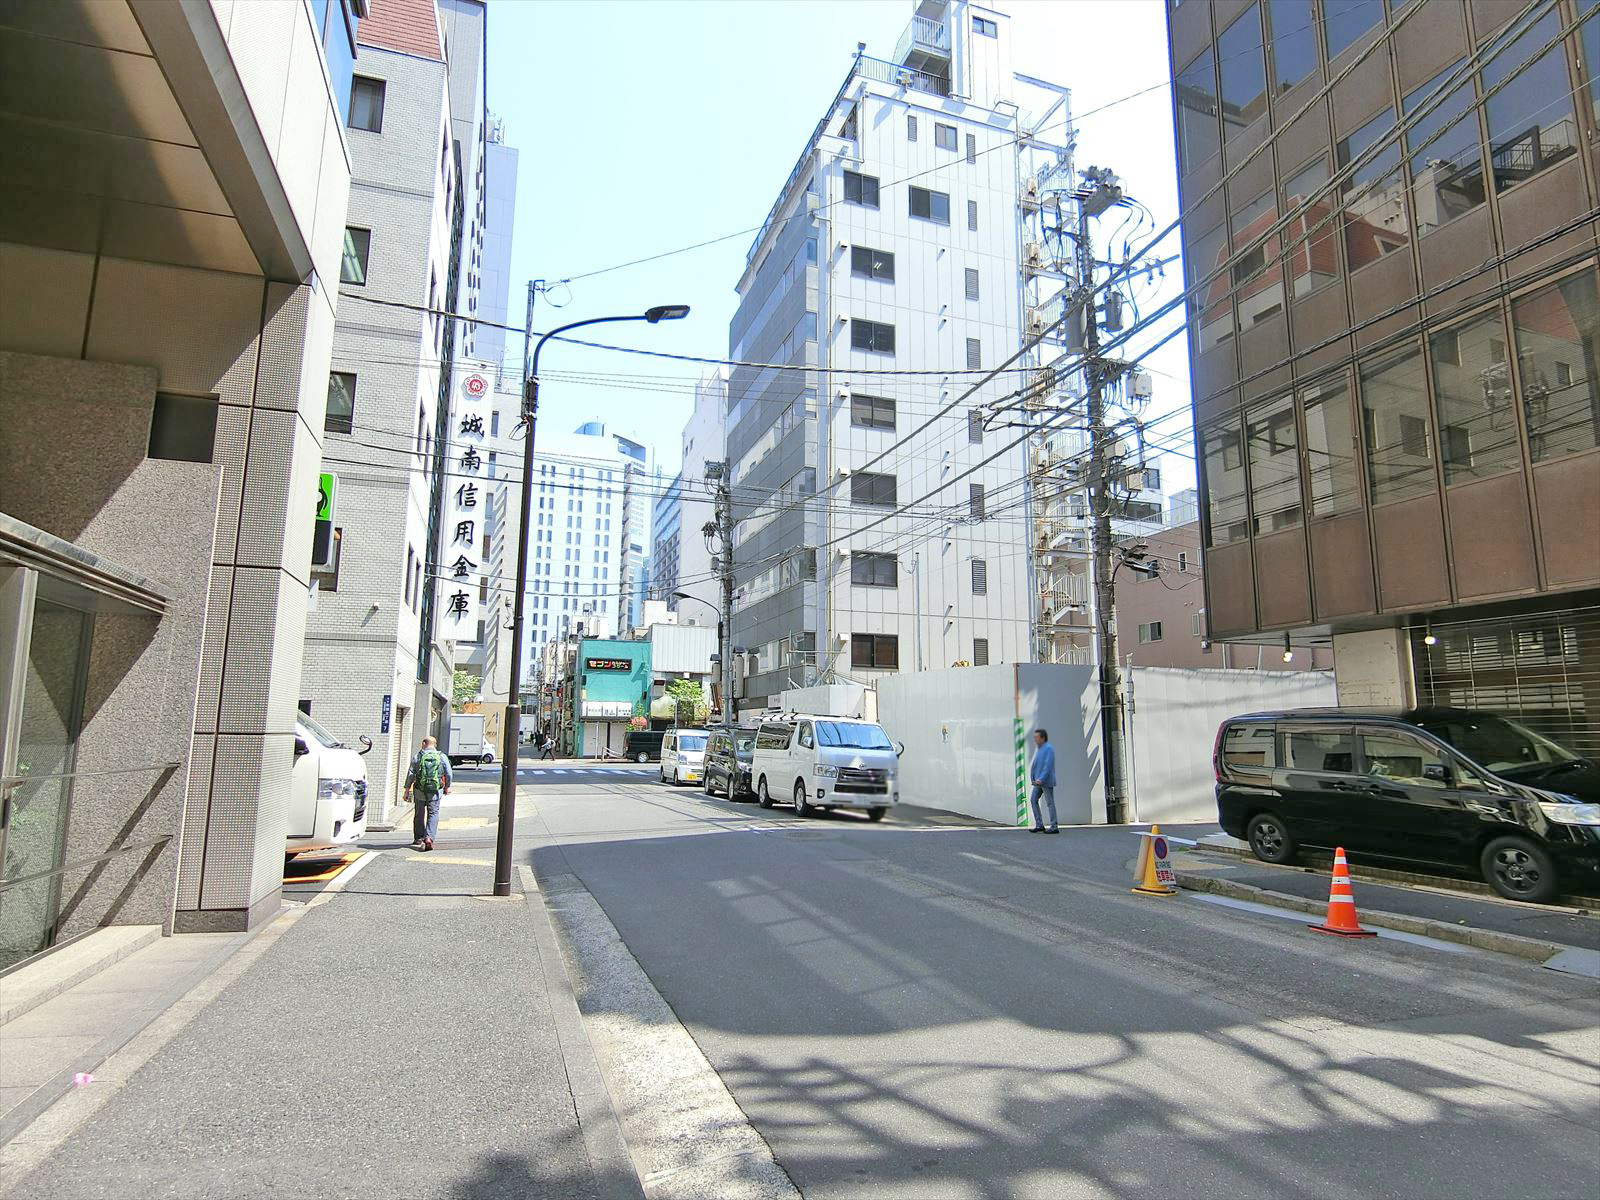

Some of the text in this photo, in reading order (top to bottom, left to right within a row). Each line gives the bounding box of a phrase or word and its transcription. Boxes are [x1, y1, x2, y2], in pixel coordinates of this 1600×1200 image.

[445, 413, 485, 620] 城南信用金庫
